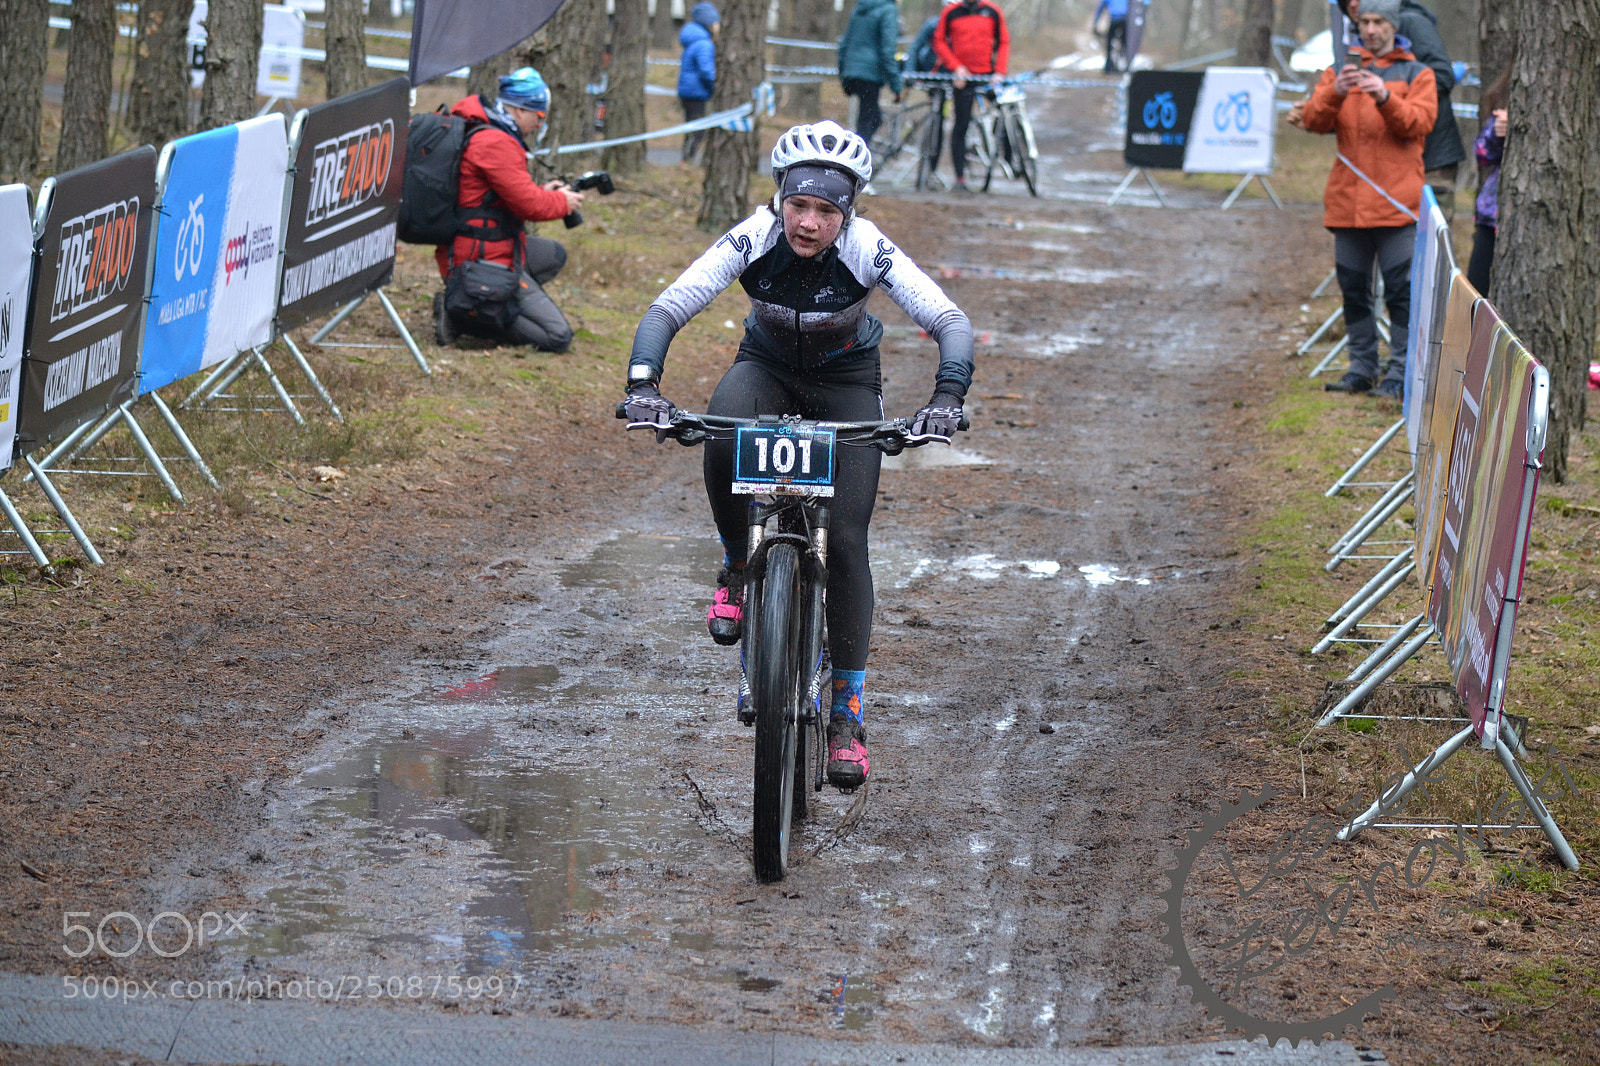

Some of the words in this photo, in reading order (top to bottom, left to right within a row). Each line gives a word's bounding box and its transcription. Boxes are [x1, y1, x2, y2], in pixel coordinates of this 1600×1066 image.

[306, 119, 394, 226] TREZADO
[51, 197, 139, 322] TREZADO
[755, 437, 811, 474] 101
